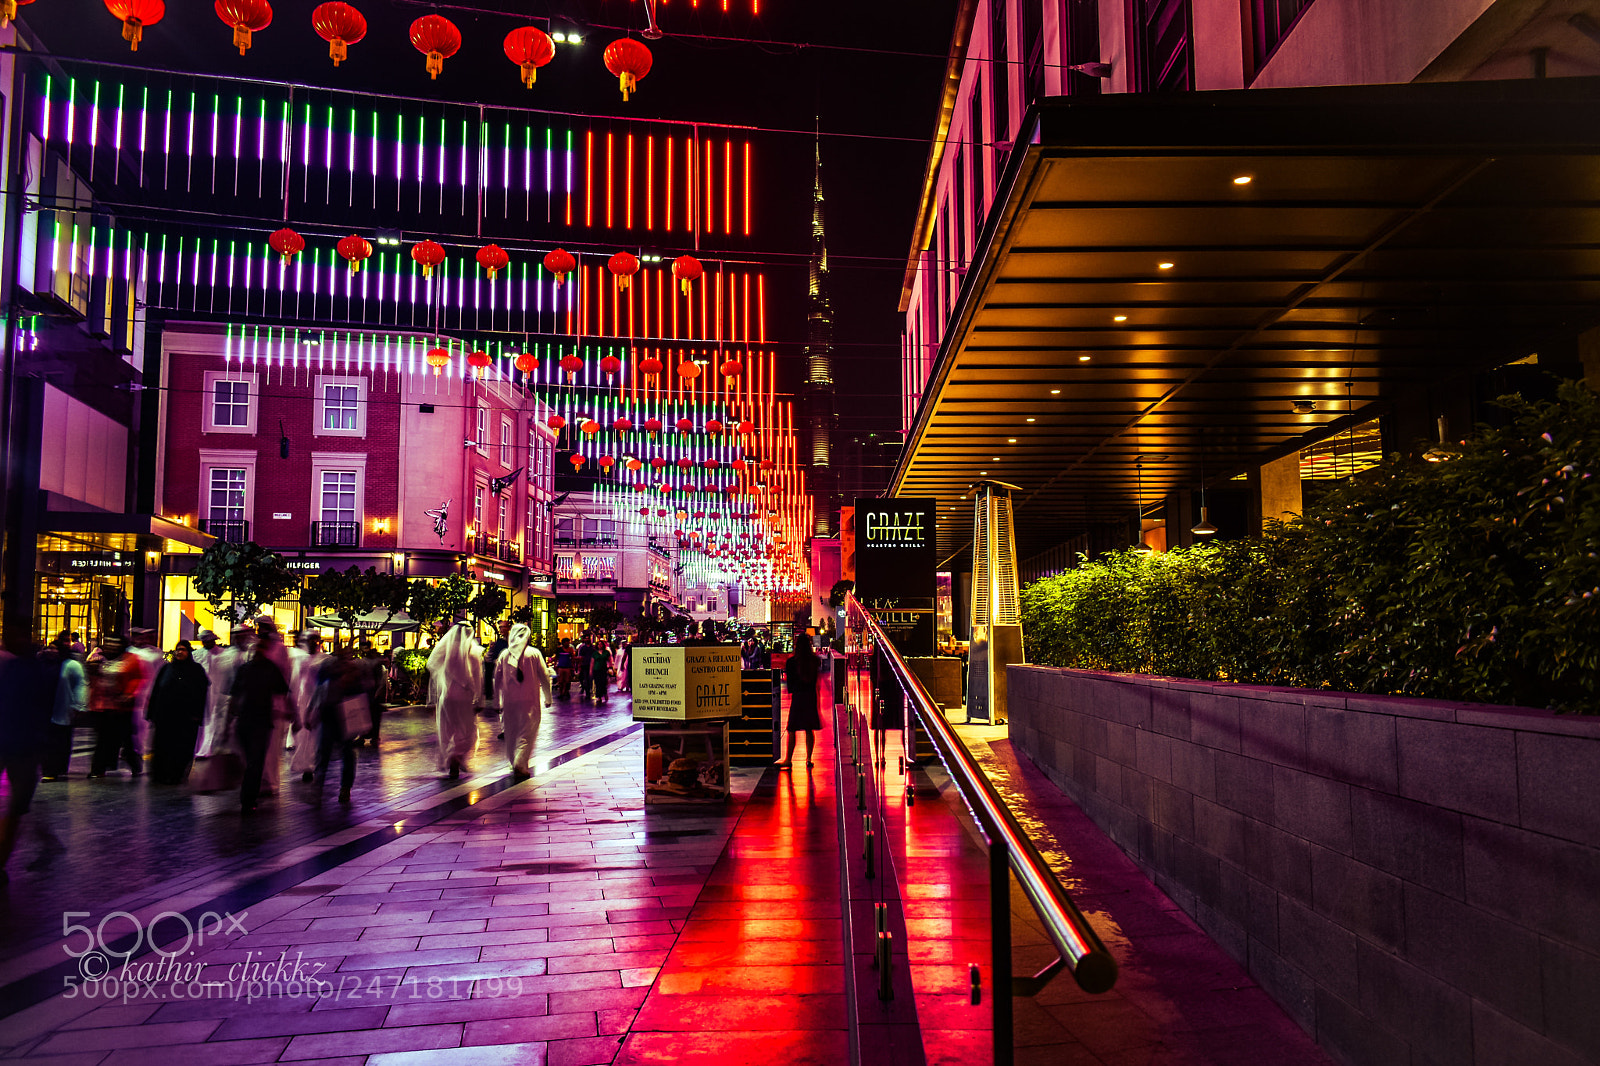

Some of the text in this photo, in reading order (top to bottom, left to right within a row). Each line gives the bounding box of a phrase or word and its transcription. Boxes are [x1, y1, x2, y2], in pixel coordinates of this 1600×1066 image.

[866, 512, 925, 541] GRAZE
[642, 656, 672, 664] SATURDAY
[645, 668, 669, 676] BRUNCH
[696, 684, 730, 707] GRAZE
